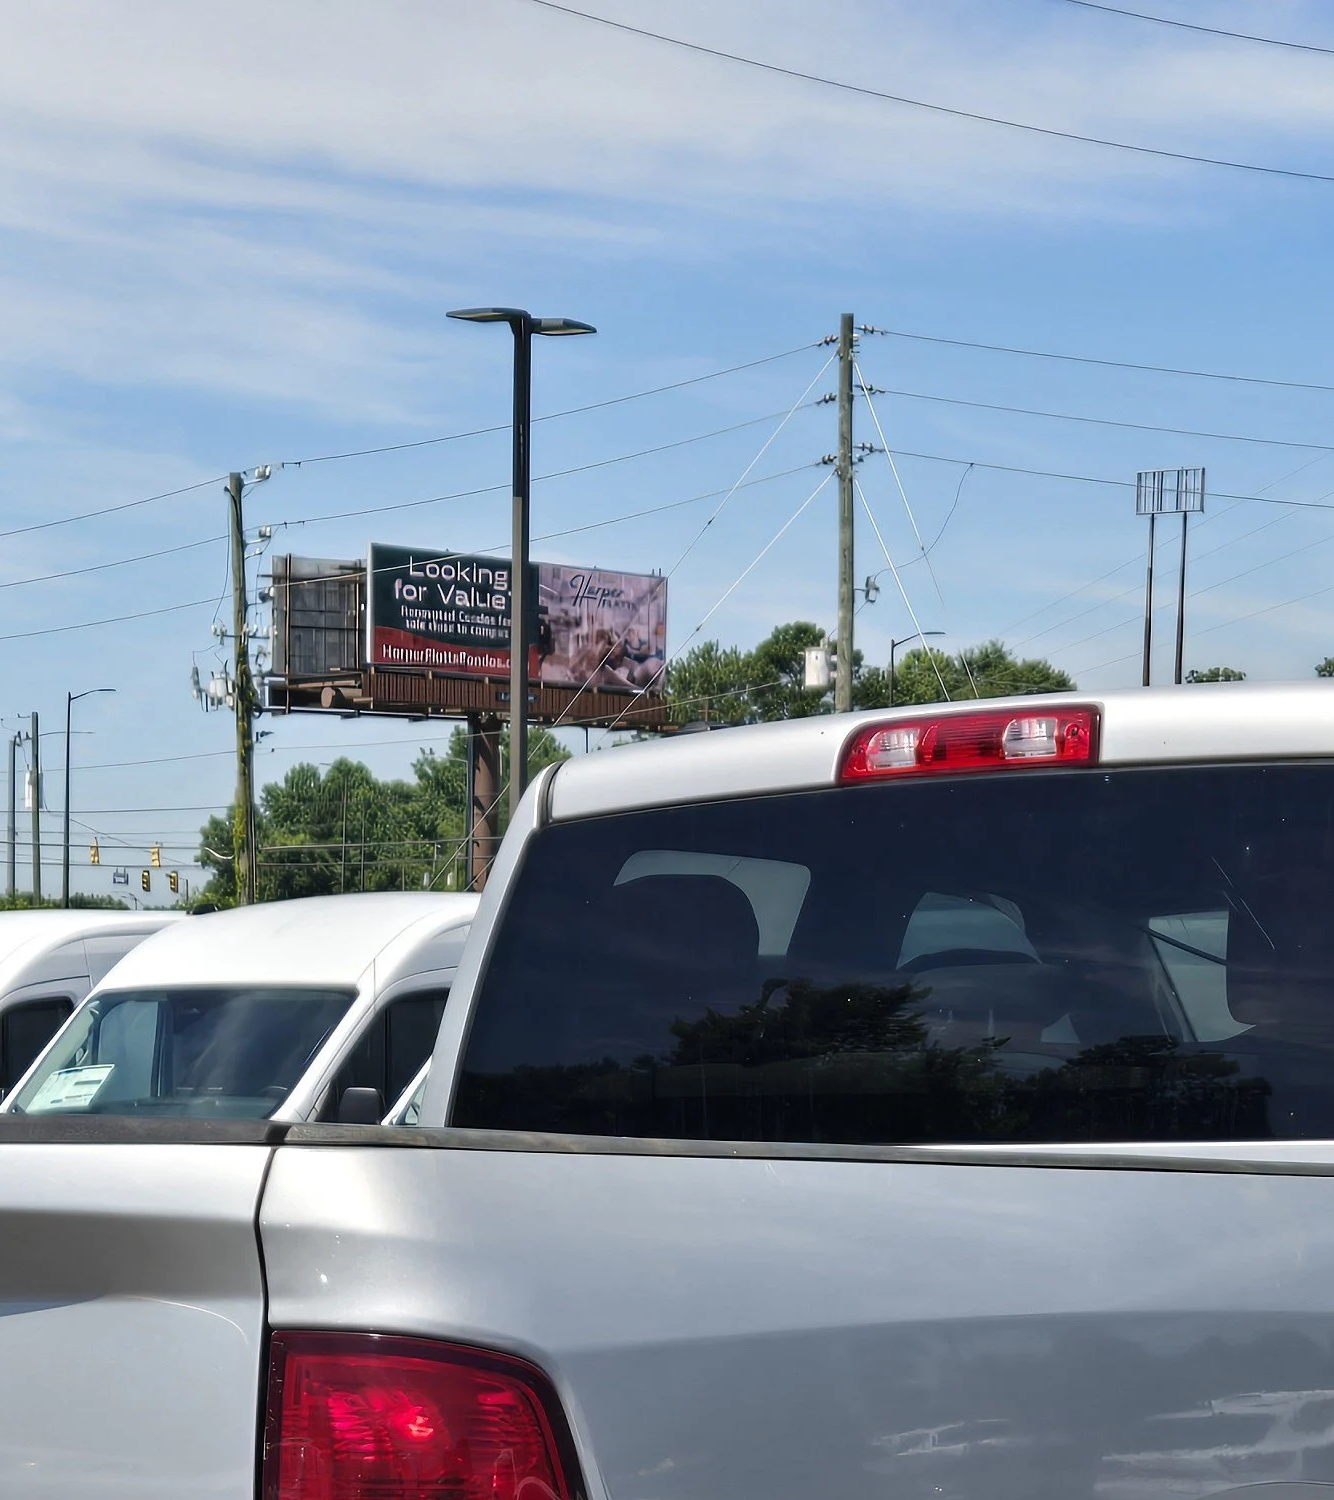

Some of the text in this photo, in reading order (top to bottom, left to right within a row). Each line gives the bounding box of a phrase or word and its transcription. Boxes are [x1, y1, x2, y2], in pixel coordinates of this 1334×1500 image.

[409, 556, 508, 590] Looking
[395, 578, 511, 609] for Value
[569, 574, 624, 608] Harper
